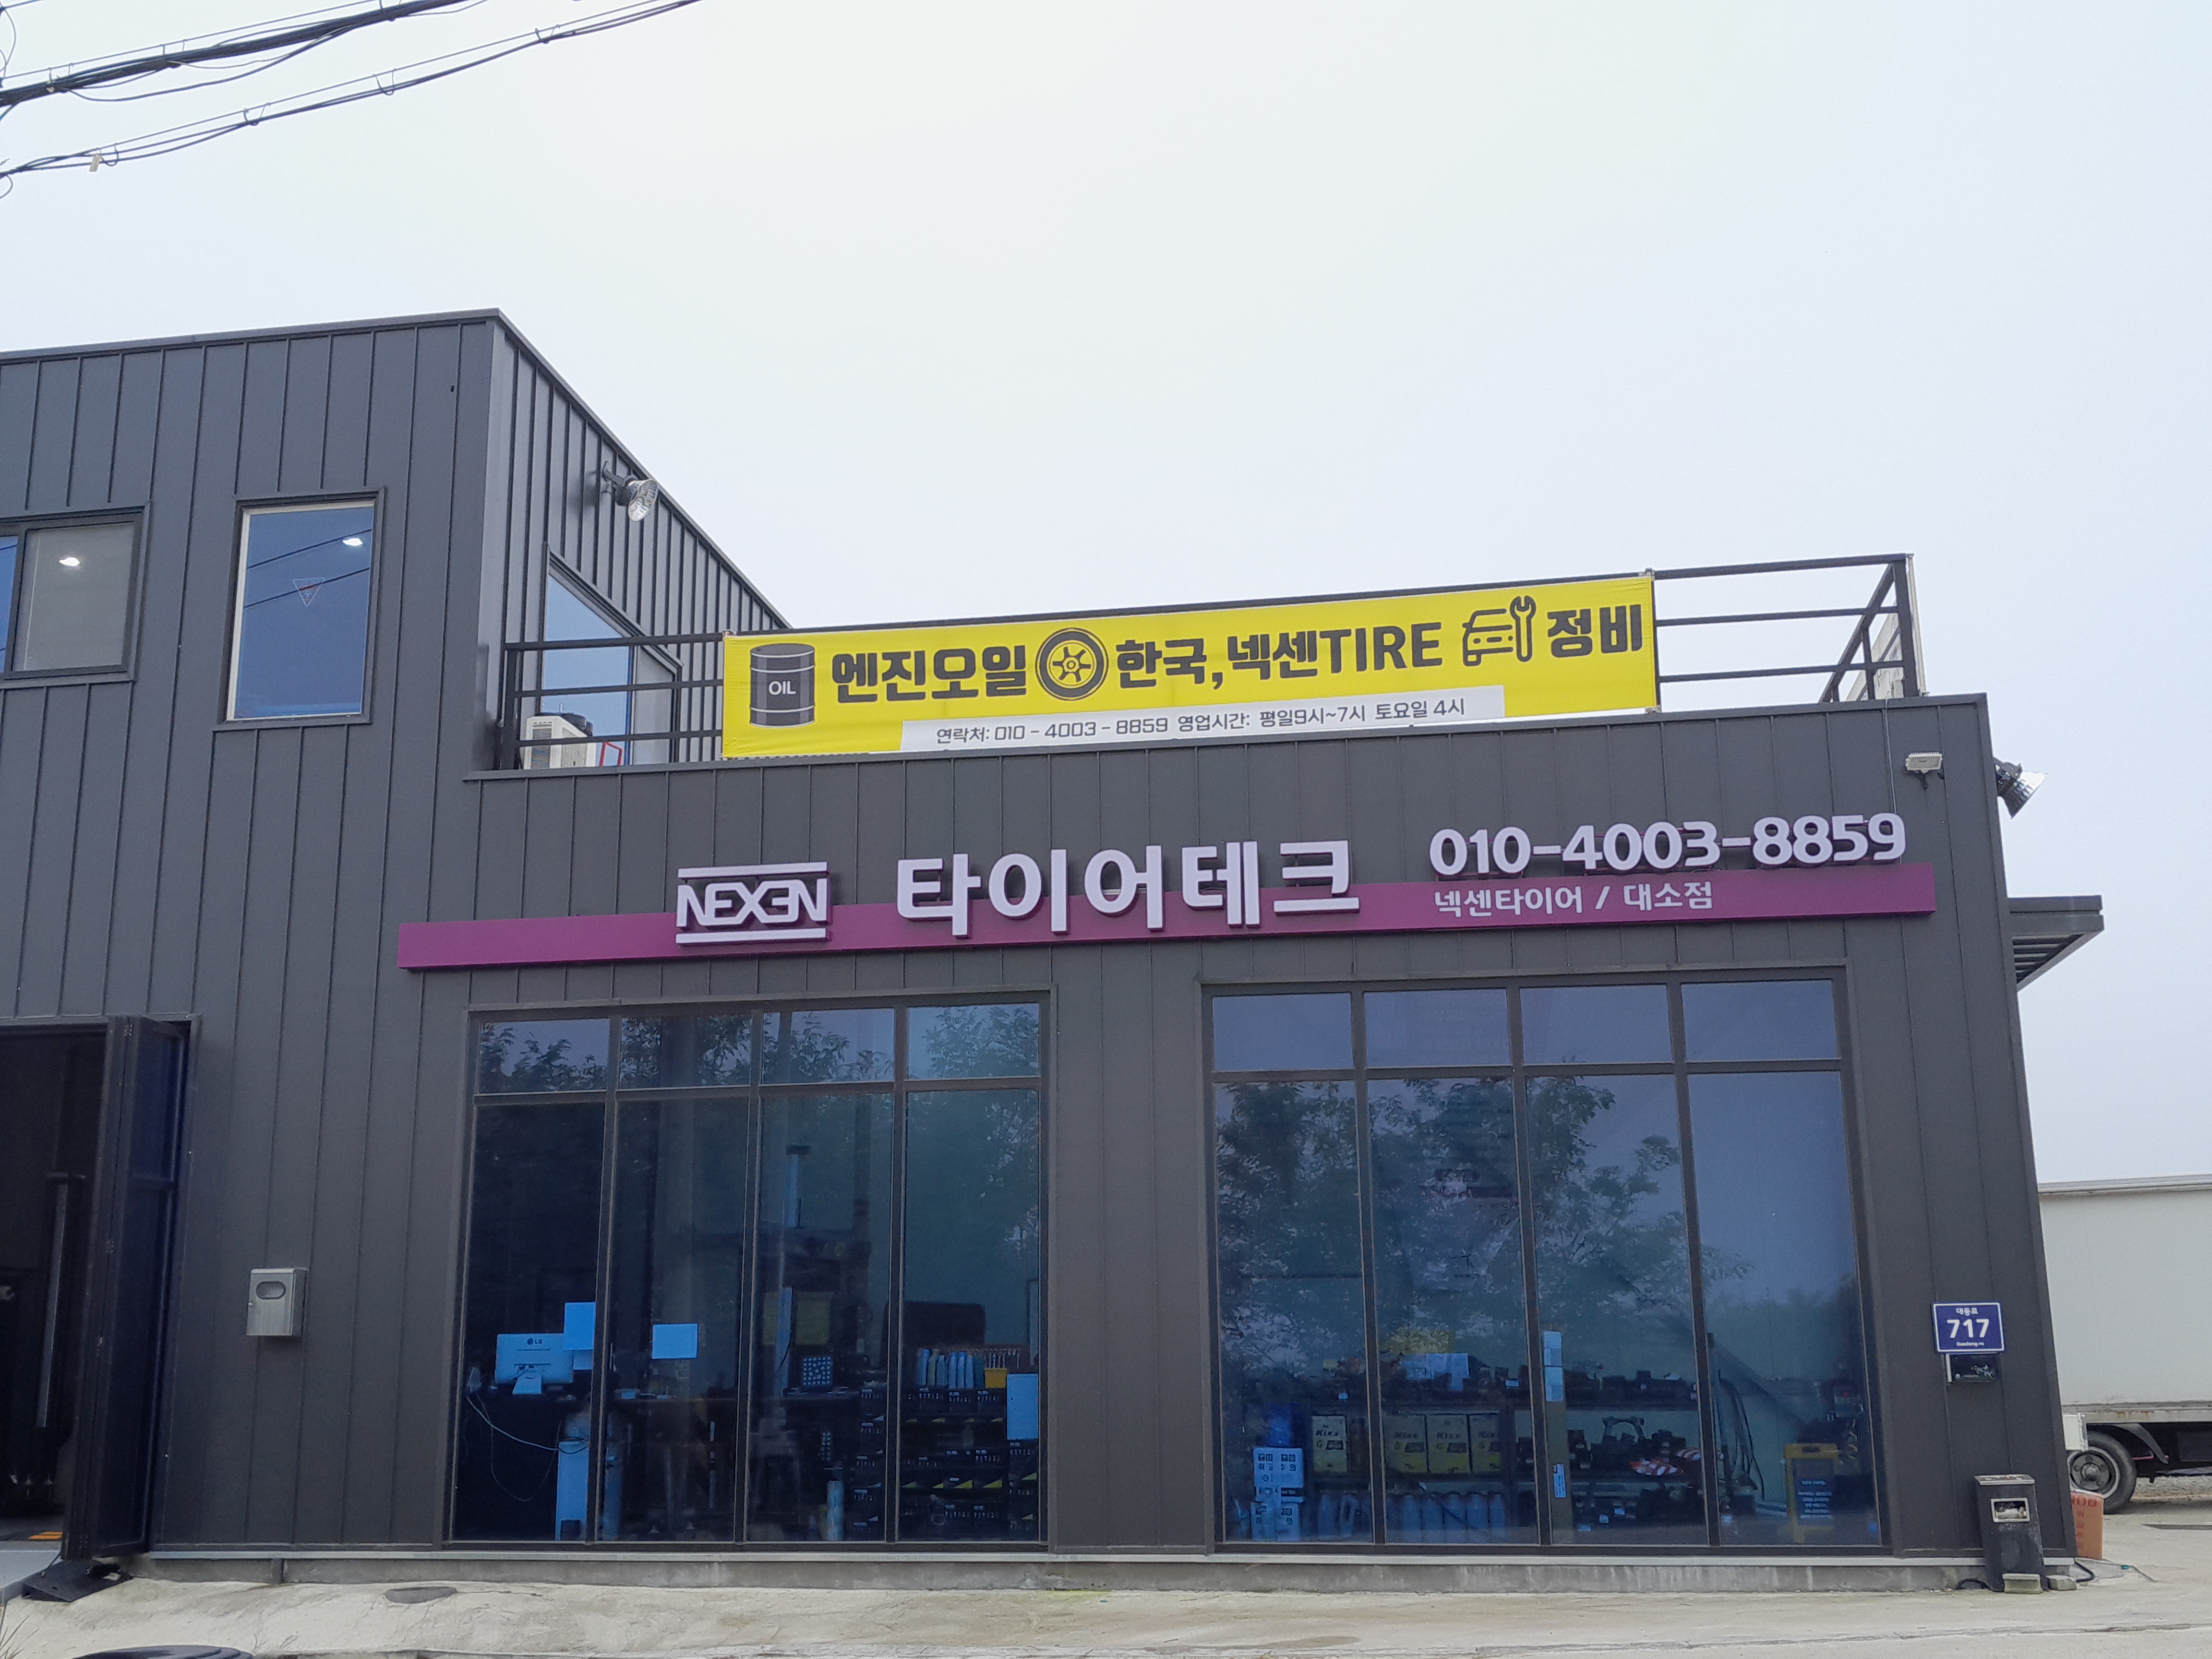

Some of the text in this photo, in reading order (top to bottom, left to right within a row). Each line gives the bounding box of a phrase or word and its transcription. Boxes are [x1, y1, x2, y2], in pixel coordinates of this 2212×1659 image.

[832, 645, 1027, 703] 엔진오일
[1547, 604, 1643, 658] 정비
[769, 681, 796, 696] OIL
[1178, 712, 1250, 732] 영업시간:
[1374, 700, 1428, 720] 토요일
[1432, 697, 1465, 716] 4시
[1429, 813, 1906, 876] 010-4003-8859
[675, 878, 829, 928] NEXEN
[897, 840, 1360, 939] 타이어테크
[1434, 886, 1583, 917] 넥센타이어
[1623, 881, 1713, 910] 대소점
[1947, 1318, 1989, 1338] 717
